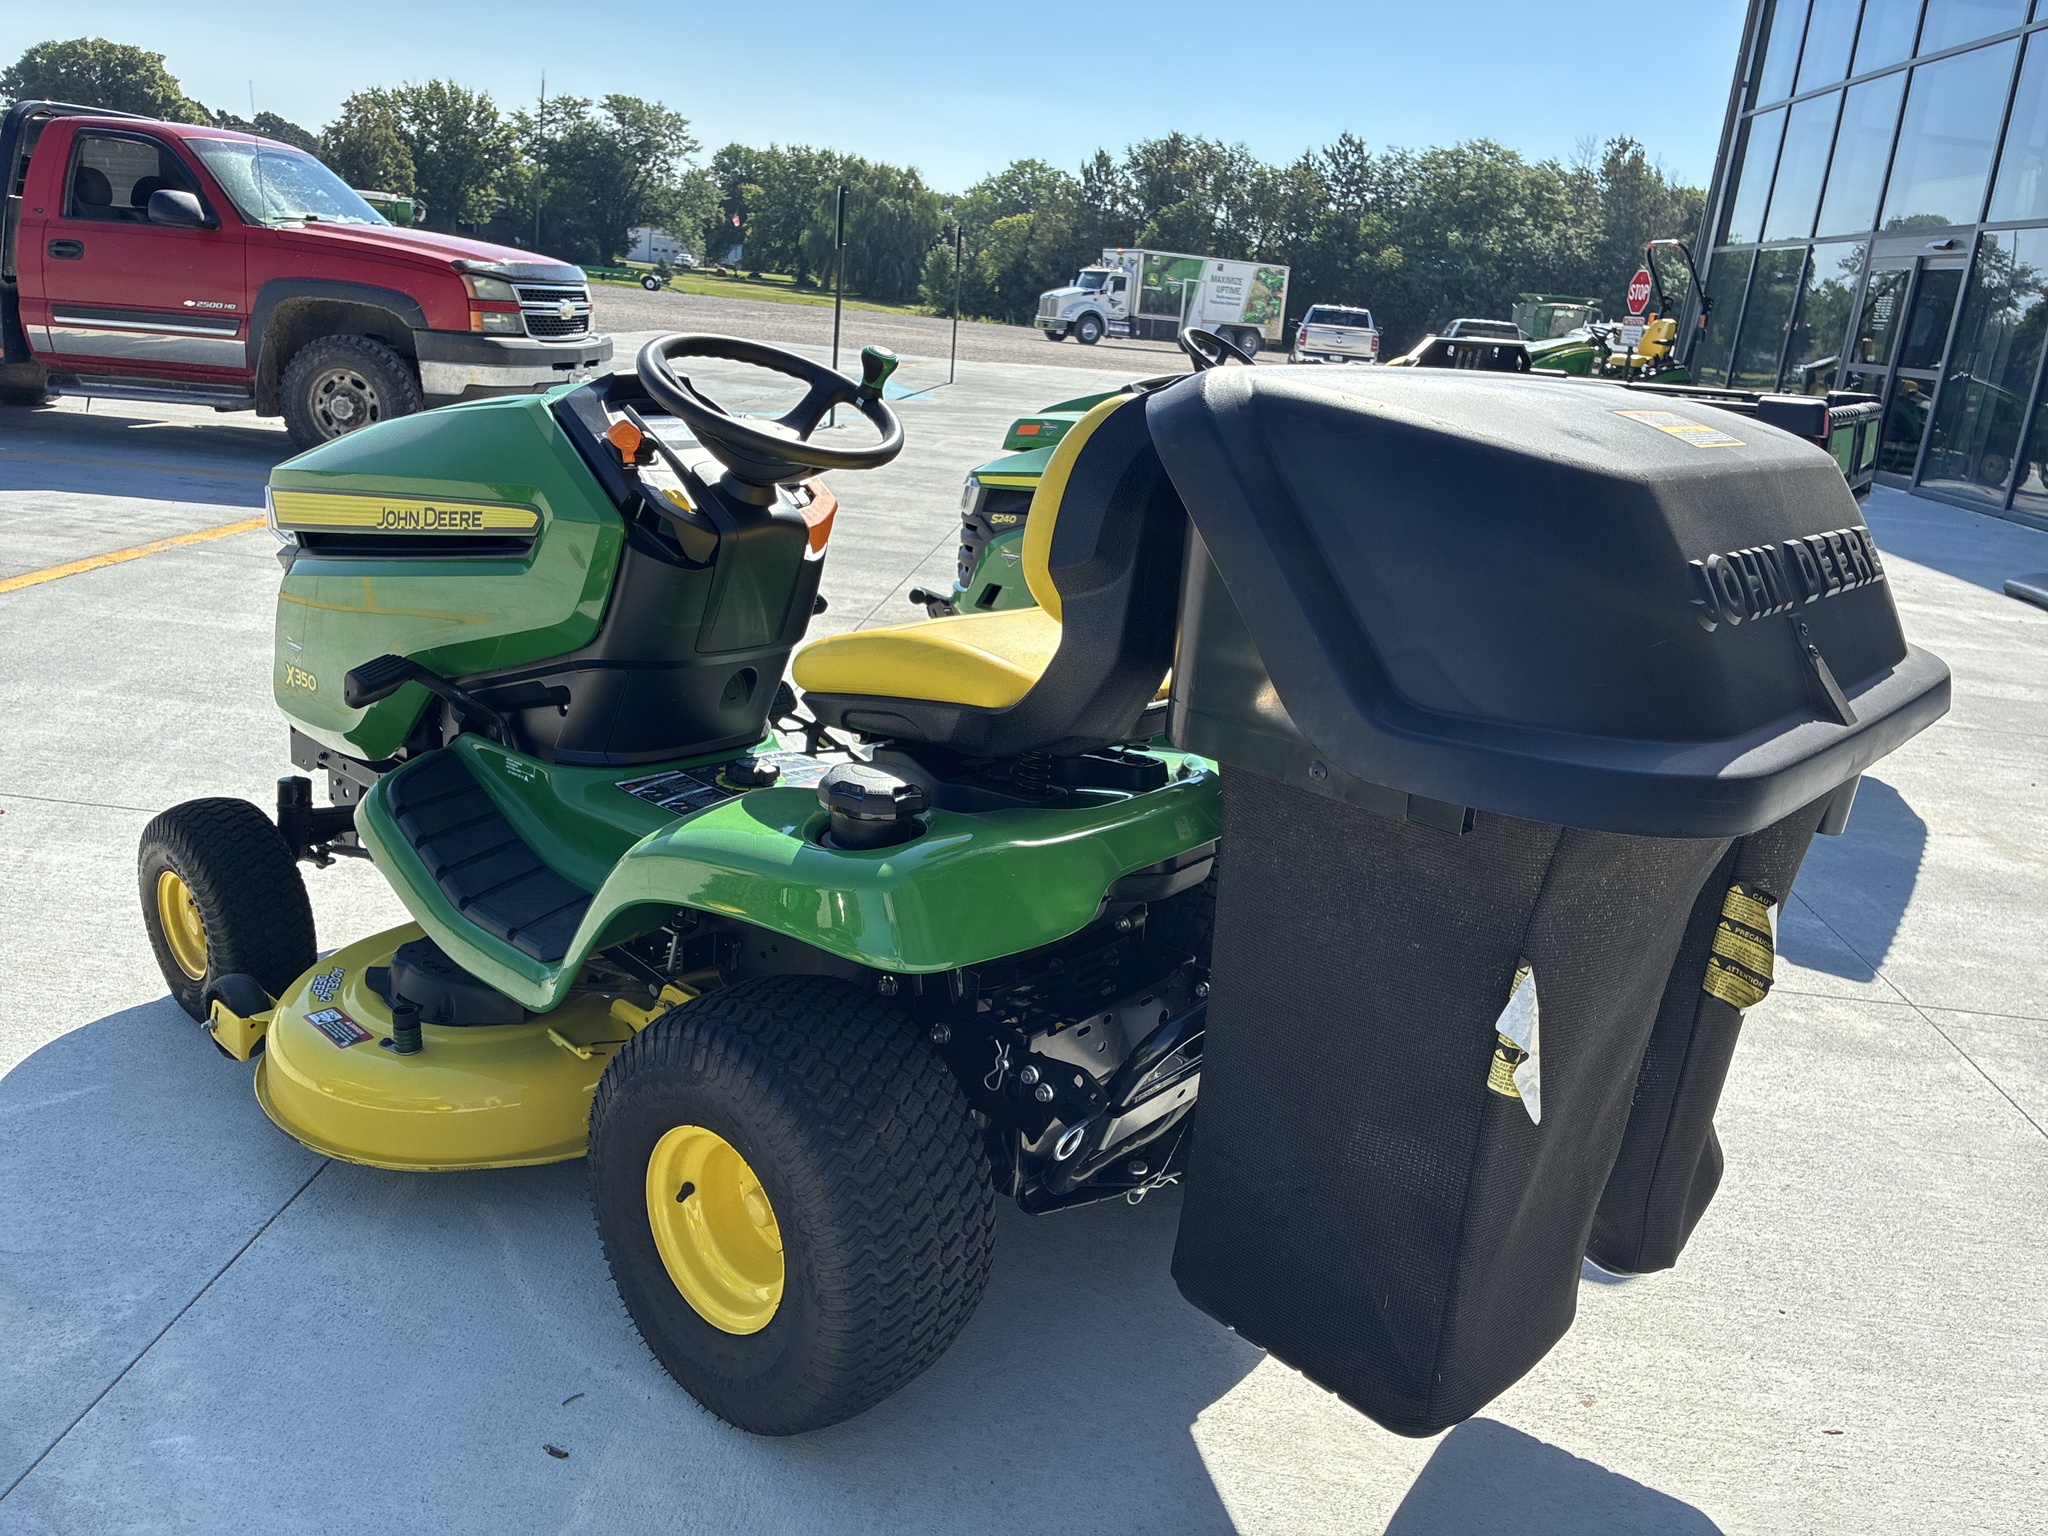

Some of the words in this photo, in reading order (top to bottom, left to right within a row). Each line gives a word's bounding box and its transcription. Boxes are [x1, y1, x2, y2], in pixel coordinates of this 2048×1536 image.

[1628, 283, 1650, 301] STOP
[196, 300, 223, 309] 2500
[377, 506, 420, 527] JOHN
[424, 506, 483, 528] DEERE
[990, 514, 1017, 524] S240
[1688, 544, 1794, 632] JOHN
[1782, 525, 1885, 604] DEERE
[285, 662, 317, 692] X350
[312, 974, 329, 996] DEEP
[325, 966, 345, 993] ACCEL
[1725, 964, 1764, 988] ATTENTION
